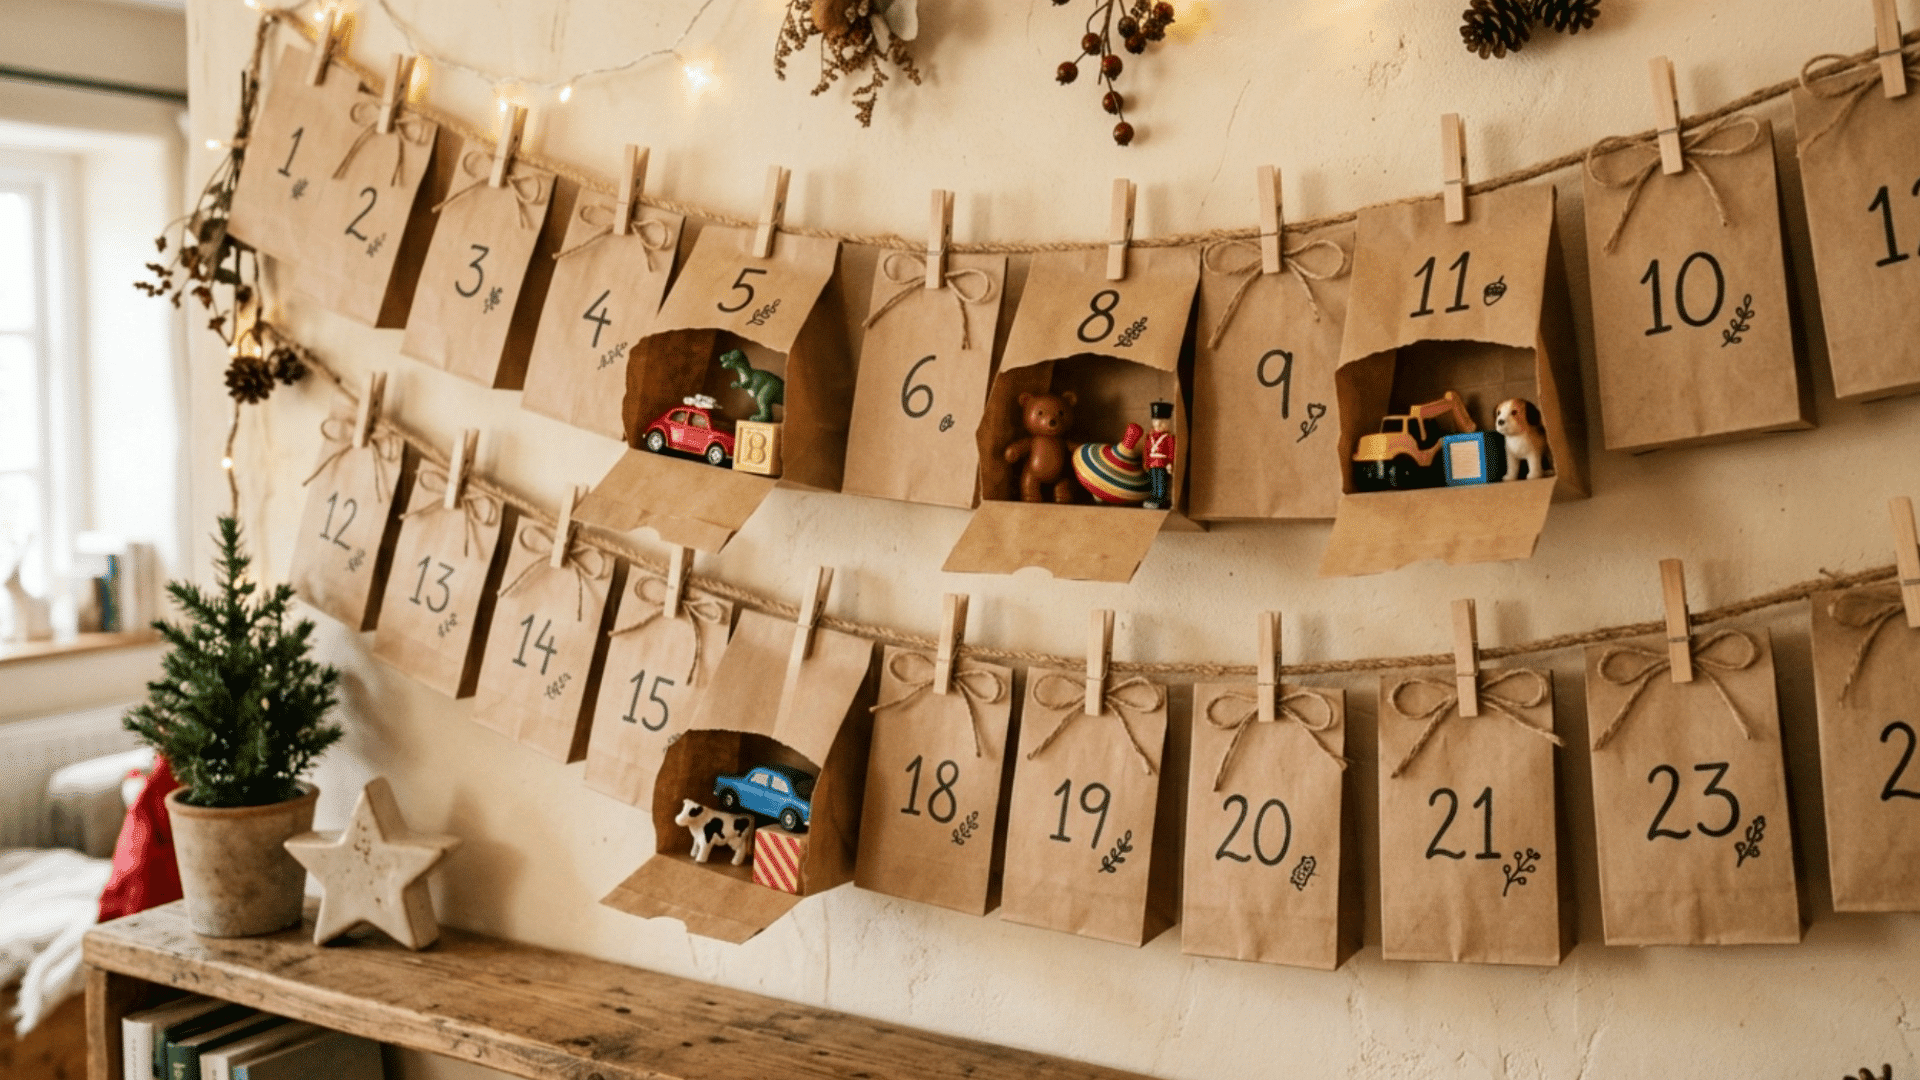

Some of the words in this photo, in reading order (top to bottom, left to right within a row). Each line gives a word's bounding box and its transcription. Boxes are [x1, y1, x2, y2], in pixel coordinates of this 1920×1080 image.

[277, 126, 304, 178] 1
[344, 186, 378, 242] 2
[1867, 178, 1920, 268] 1
[454, 243, 490, 298] 3
[717, 267, 768, 313] 5
[1409, 250, 1472, 318] 11
[1639, 251, 1726, 337] 10
[582, 289, 612, 349] 4
[1076, 289, 1120, 343] 8
[901, 354, 937, 419] 6
[1256, 349, 1294, 420] 9
[745, 430, 767, 464] B
[319, 491, 358, 552] 12
[409, 555, 455, 614] 13
[512, 613, 558, 676] 14
[622, 669, 675, 732] 15
[900, 754, 959, 824] 18
[1049, 778, 1111, 850] 19
[1647, 761, 1741, 842] 23
[1215, 793, 1292, 867] 20
[1425, 786, 1502, 860] 21
